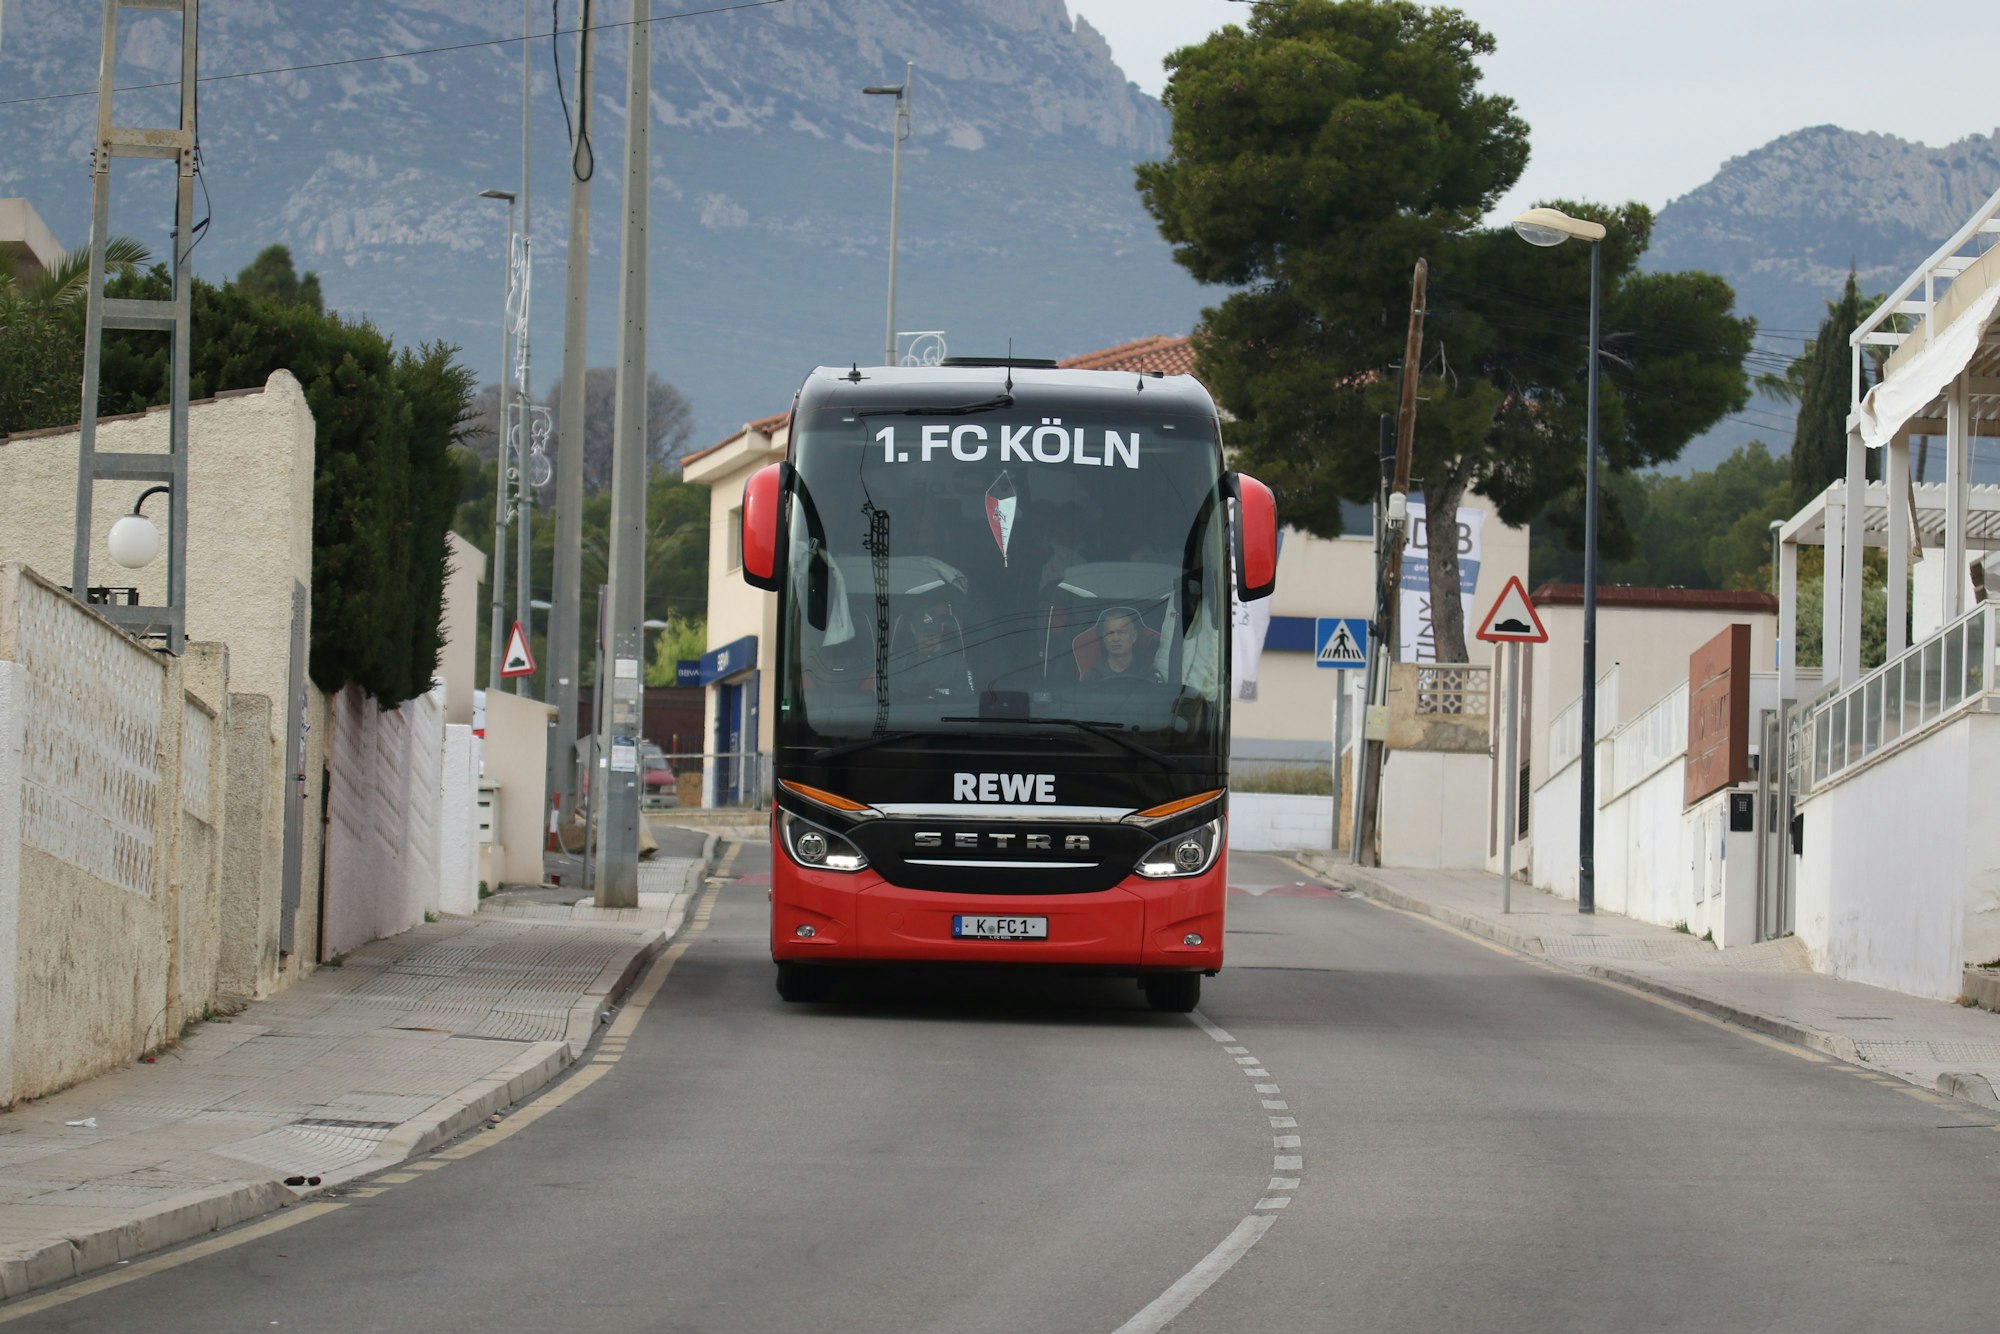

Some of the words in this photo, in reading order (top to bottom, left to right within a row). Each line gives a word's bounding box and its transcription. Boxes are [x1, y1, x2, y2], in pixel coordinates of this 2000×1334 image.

[875, 426, 908, 463] 1.
[921, 424, 988, 462] FC
[1000, 417, 1140, 469] KÖLN
[678, 669, 700, 677] BBVA
[953, 772, 1057, 803] REWE
[914, 831, 1090, 850] SETRA
